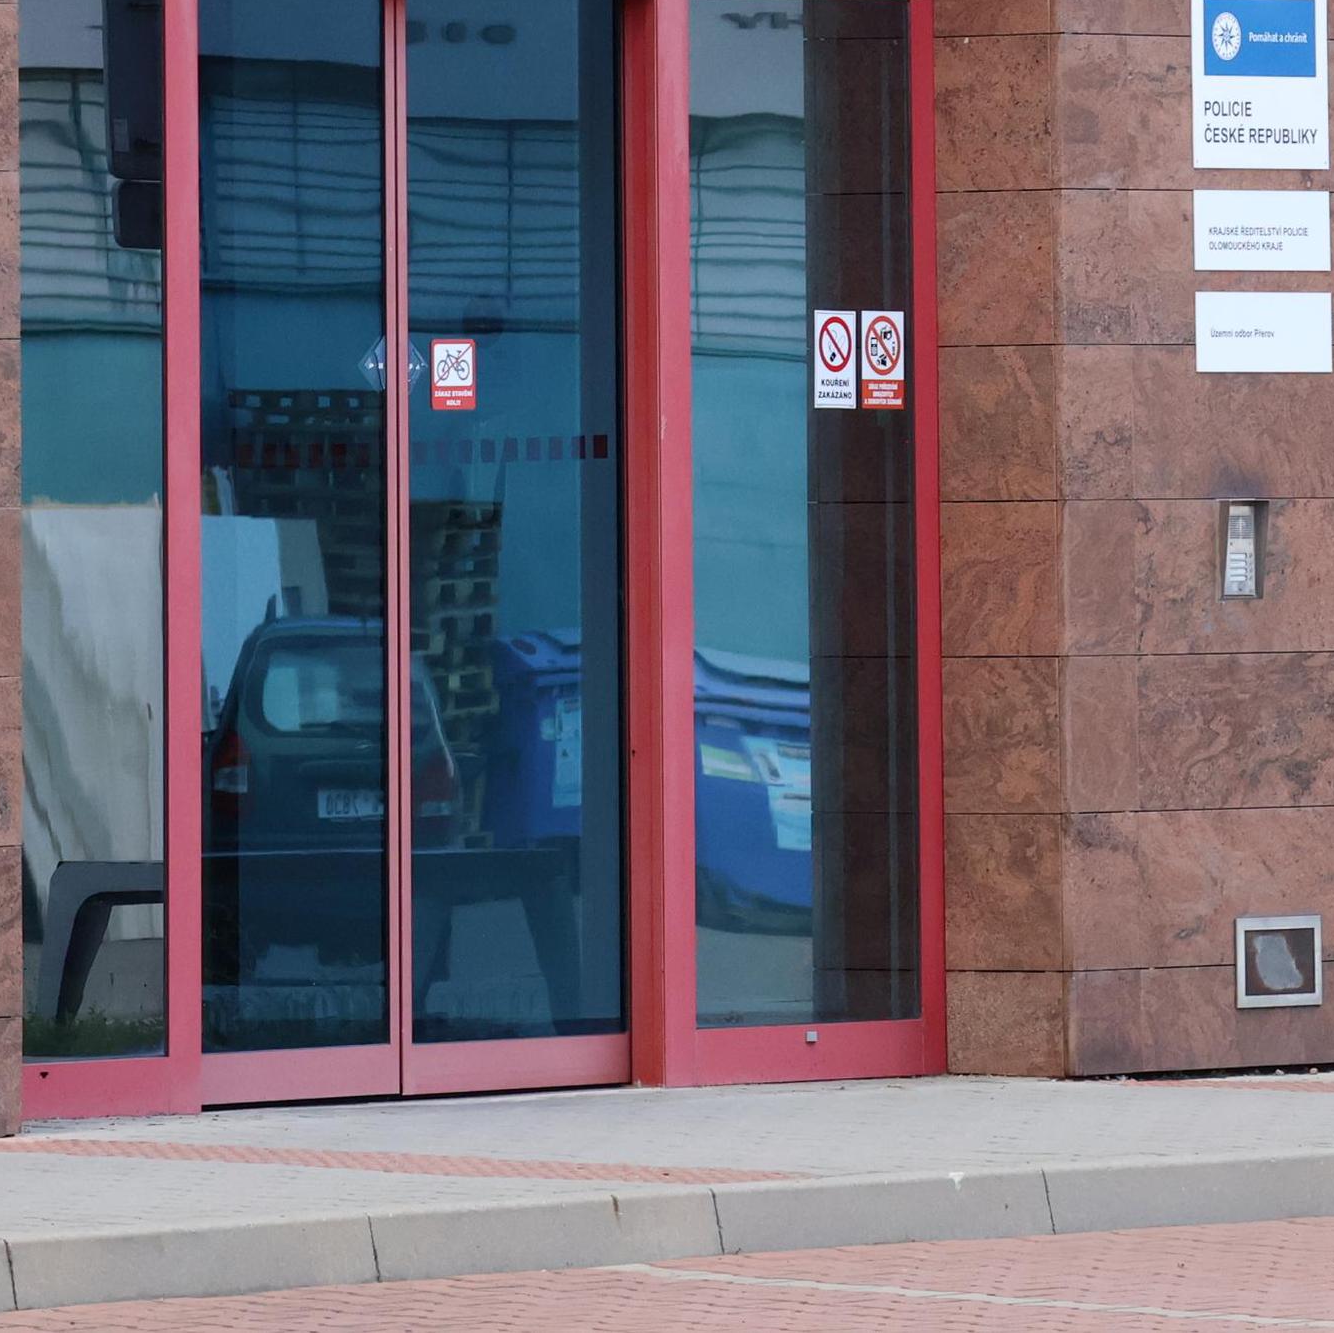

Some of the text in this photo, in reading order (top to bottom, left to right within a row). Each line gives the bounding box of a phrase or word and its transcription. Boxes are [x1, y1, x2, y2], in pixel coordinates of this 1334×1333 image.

[1249, 31, 1308, 44] Pomáhat a chránit
[1204, 101, 1252, 117] POLICIE
[1204, 123, 1318, 144] ČESKÉ REPUBLIKY
[1208, 225, 1309, 237] KRAJSKÉ ŘEDITELSTVÍ POLICIE
[1208, 240, 1283, 251] OLOMOUCKÉHO KRAJE
[1234, 328, 1253, 338] odbor
[821, 378, 850, 387] KOUŘENÍ
[818, 390, 853, 399] ZAKÁZÁNO
